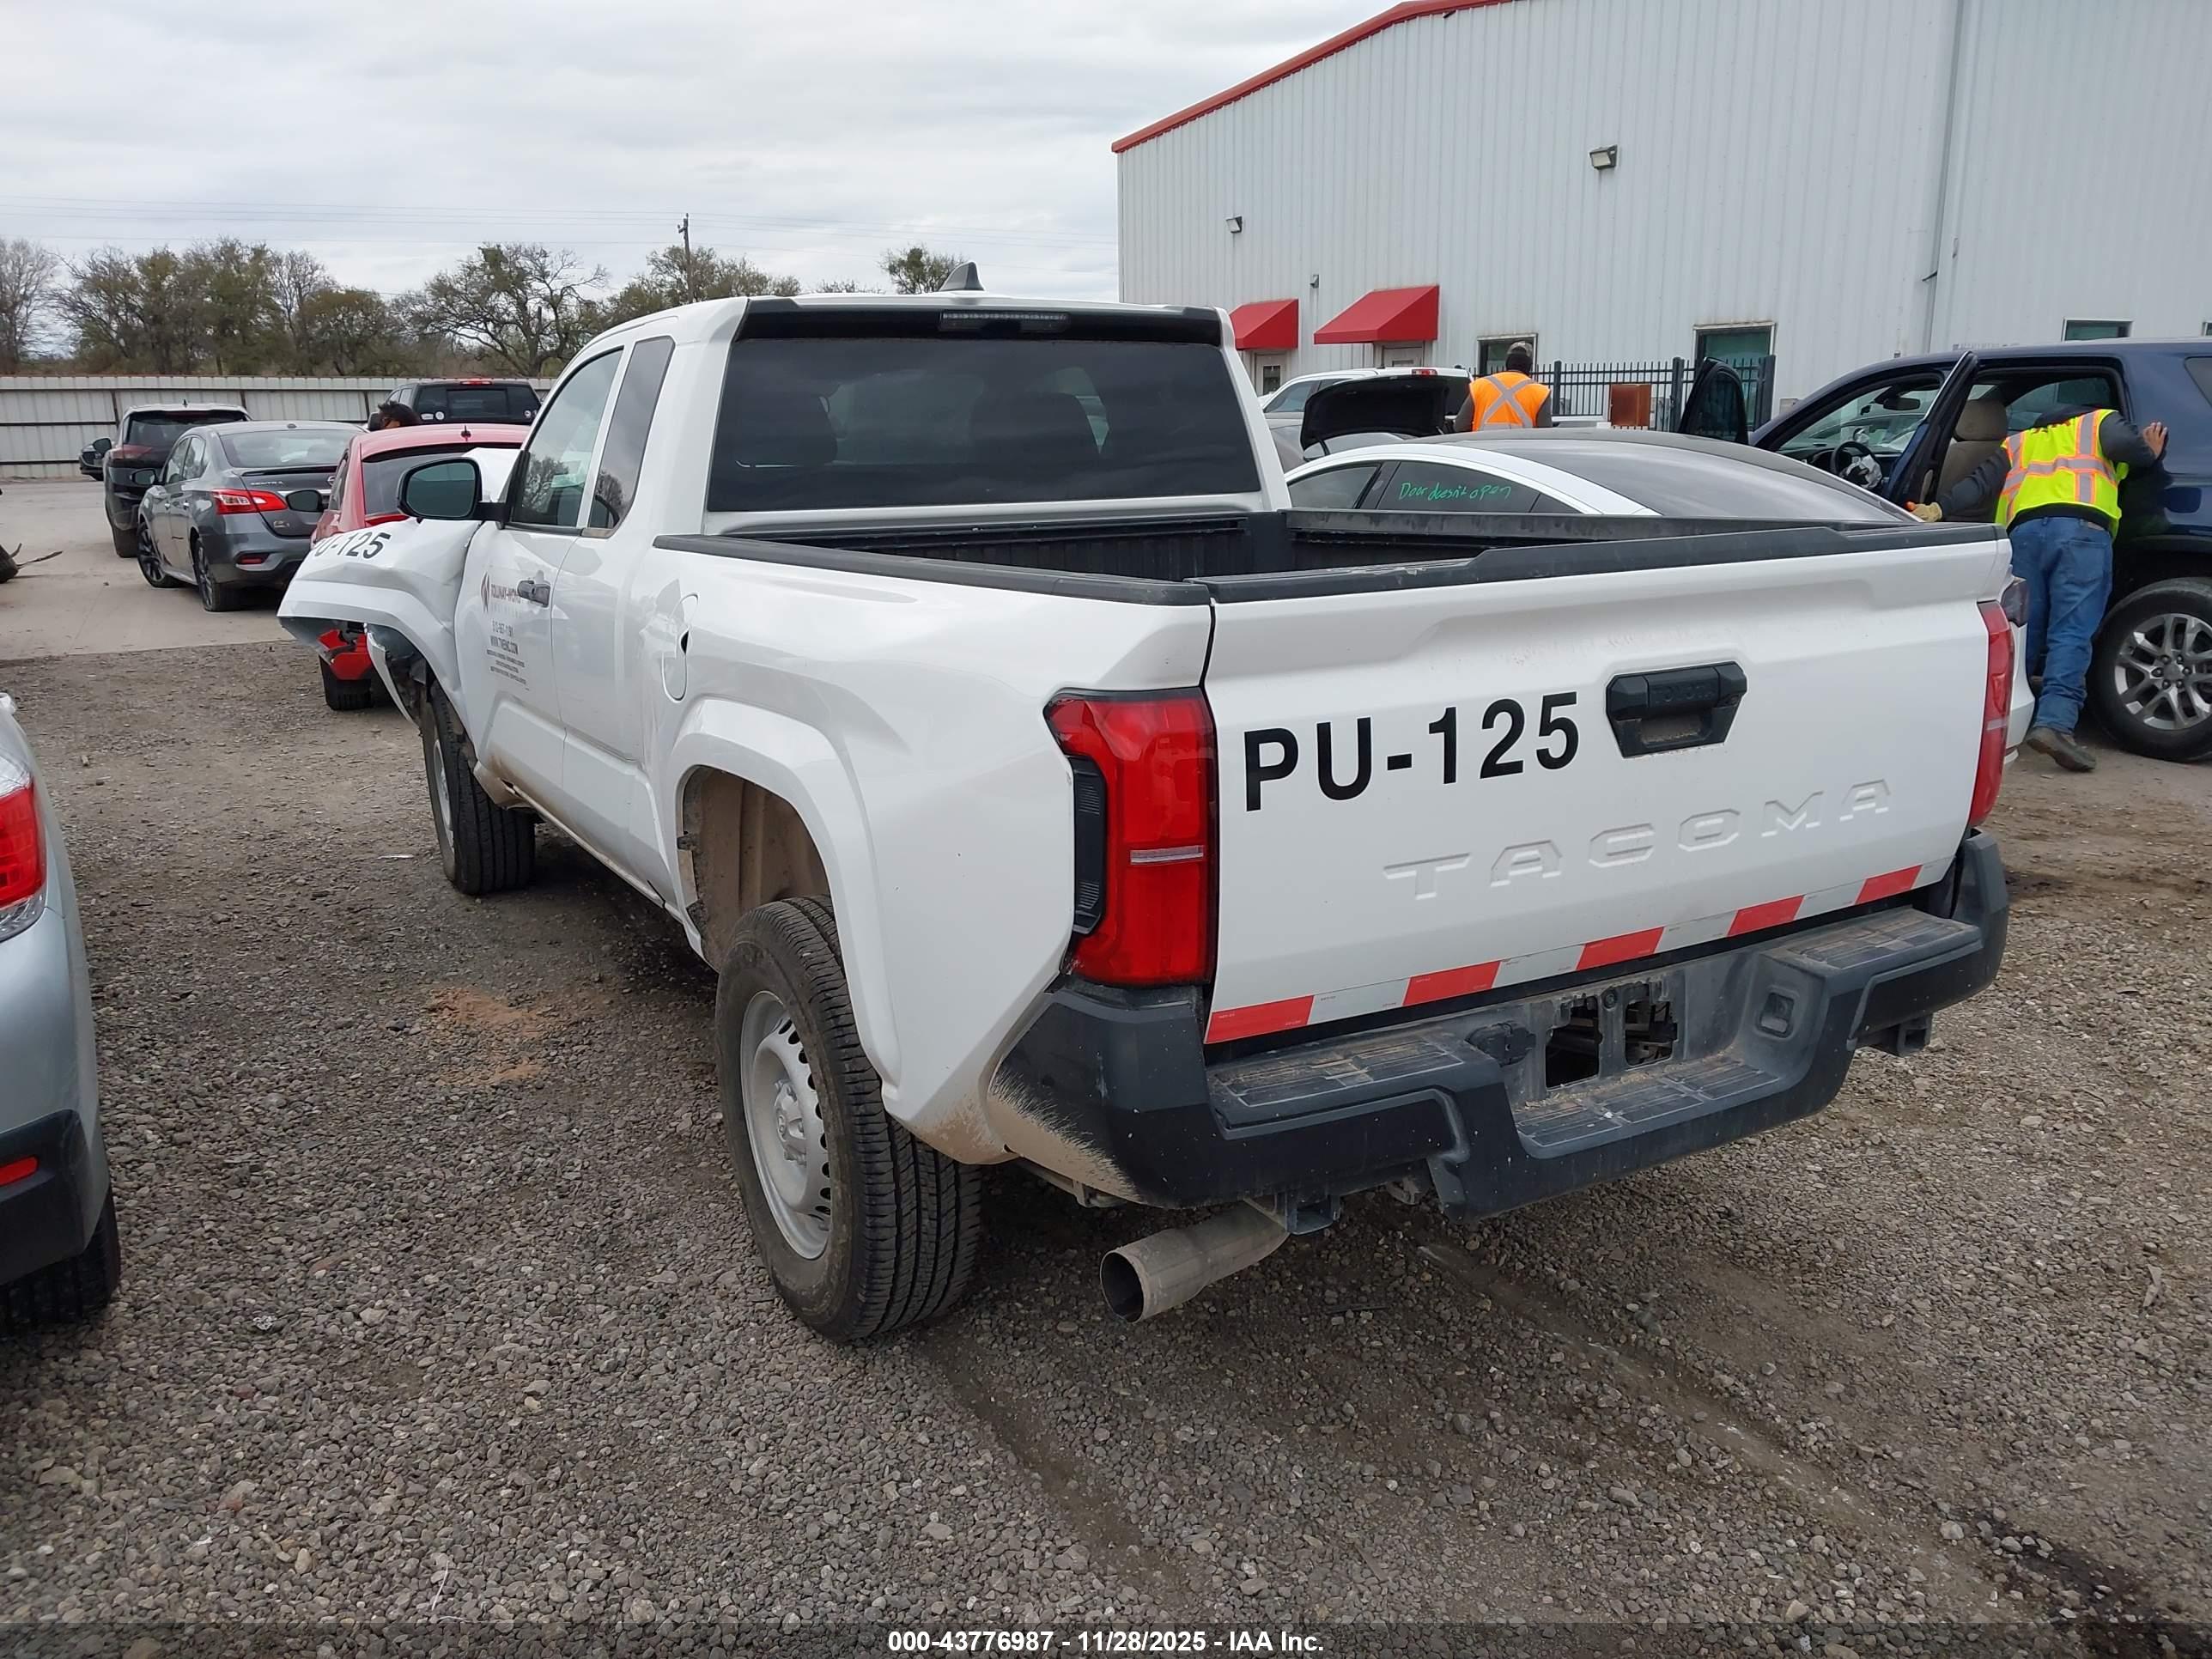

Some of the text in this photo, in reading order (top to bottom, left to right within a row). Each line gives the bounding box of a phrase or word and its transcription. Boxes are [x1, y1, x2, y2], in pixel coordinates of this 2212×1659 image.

[1399, 483, 1428, 500] Door
[1469, 484, 1511, 501] open
[1244, 691, 1579, 811] PU-125
[1383, 779, 1891, 899] TACOMA
